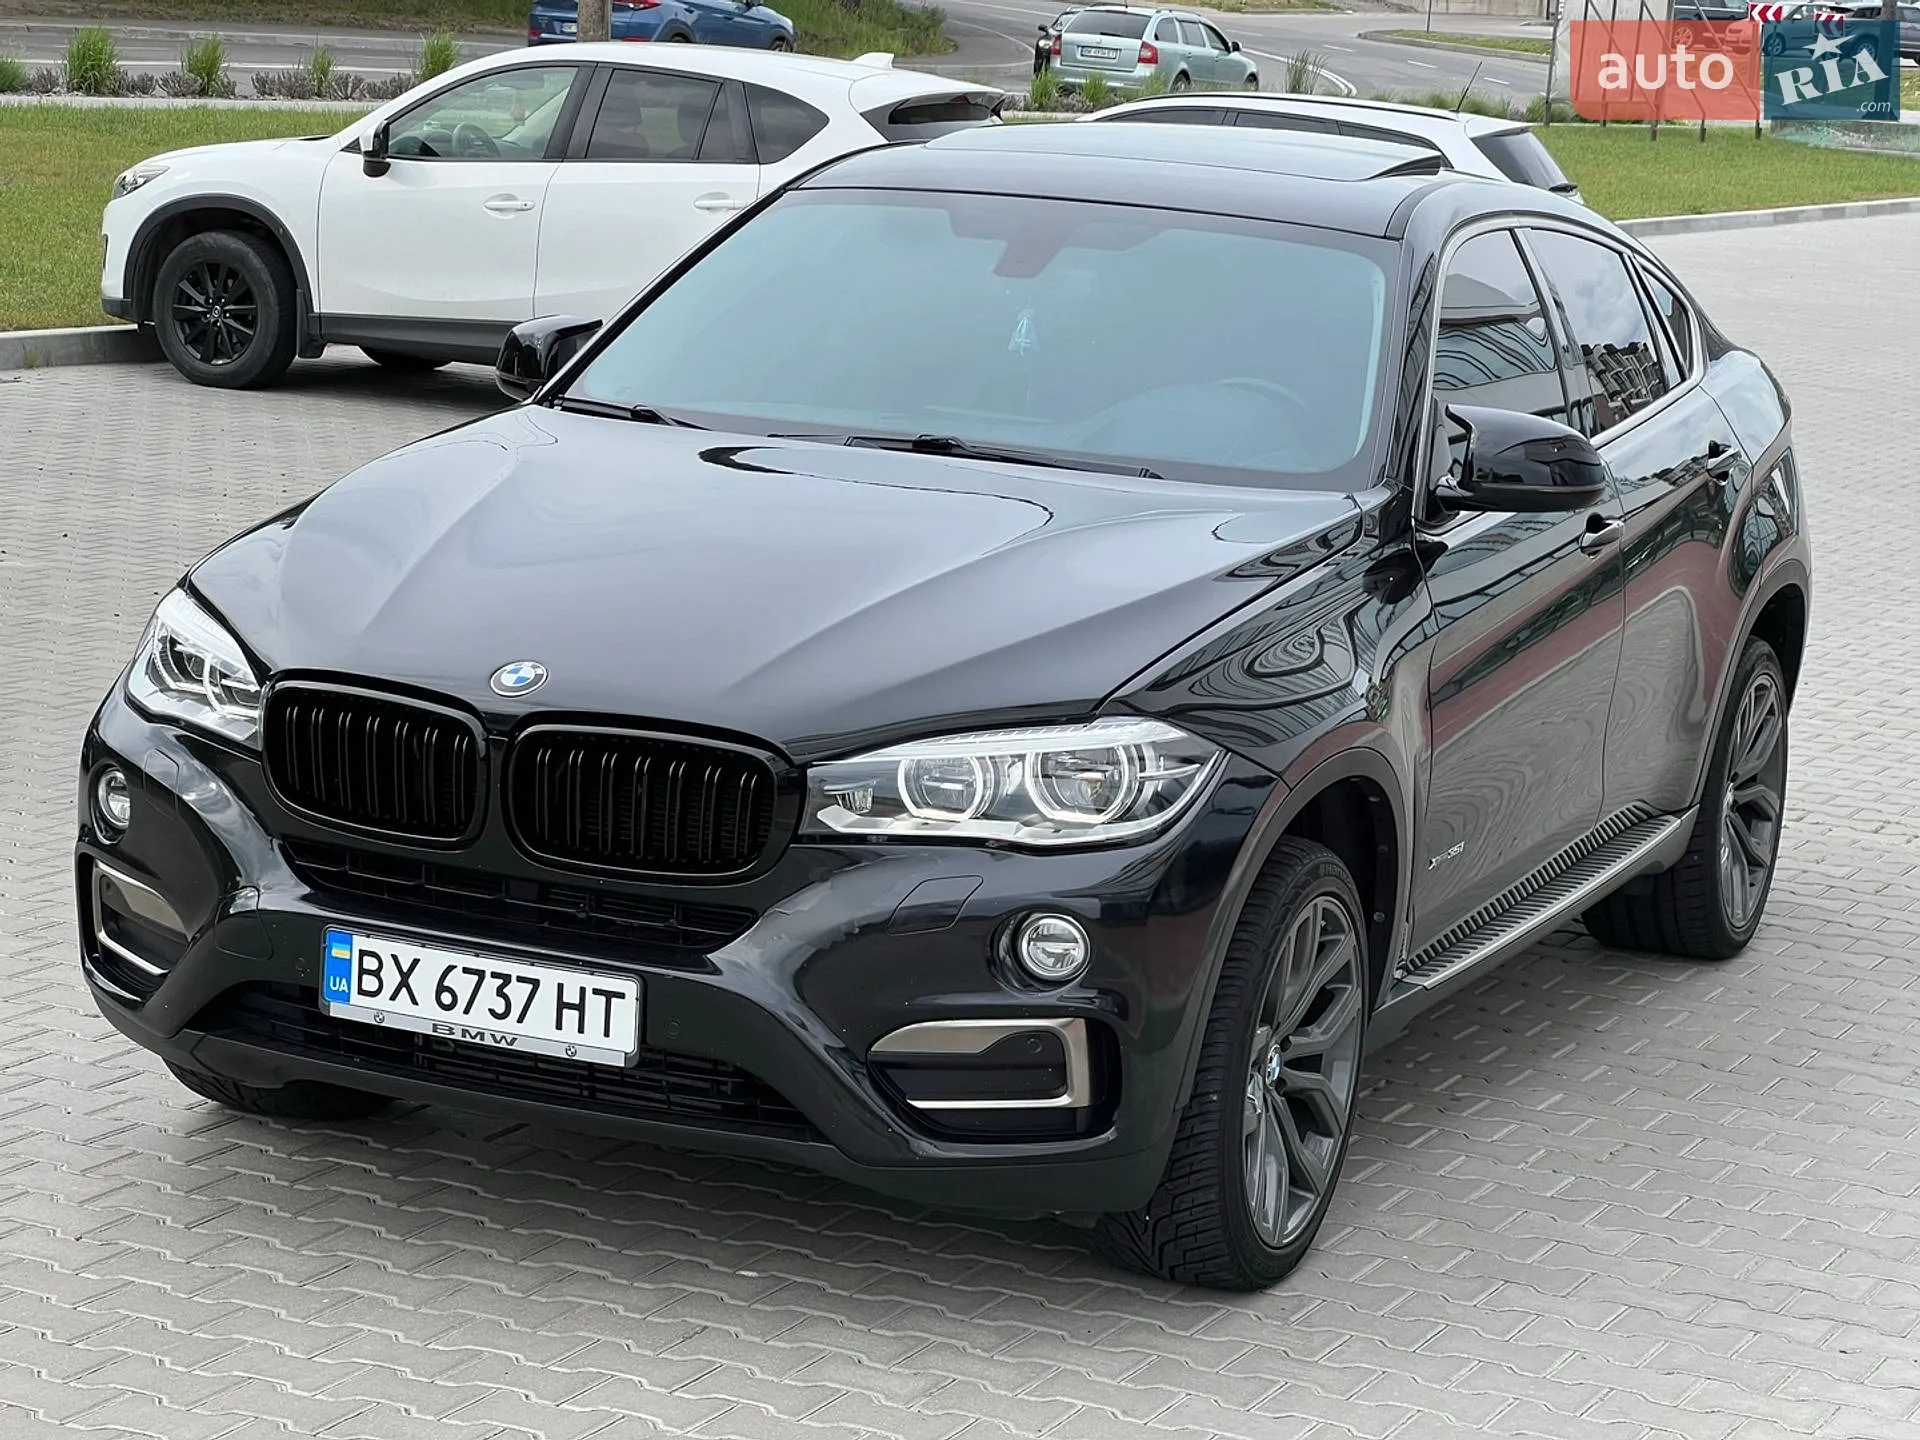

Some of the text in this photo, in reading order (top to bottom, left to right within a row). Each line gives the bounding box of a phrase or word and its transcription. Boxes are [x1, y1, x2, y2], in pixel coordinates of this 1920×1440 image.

[330, 976, 349, 993] UA
[357, 948, 627, 1038] BX 6737 HT
[431, 1023, 519, 1047] BMW
